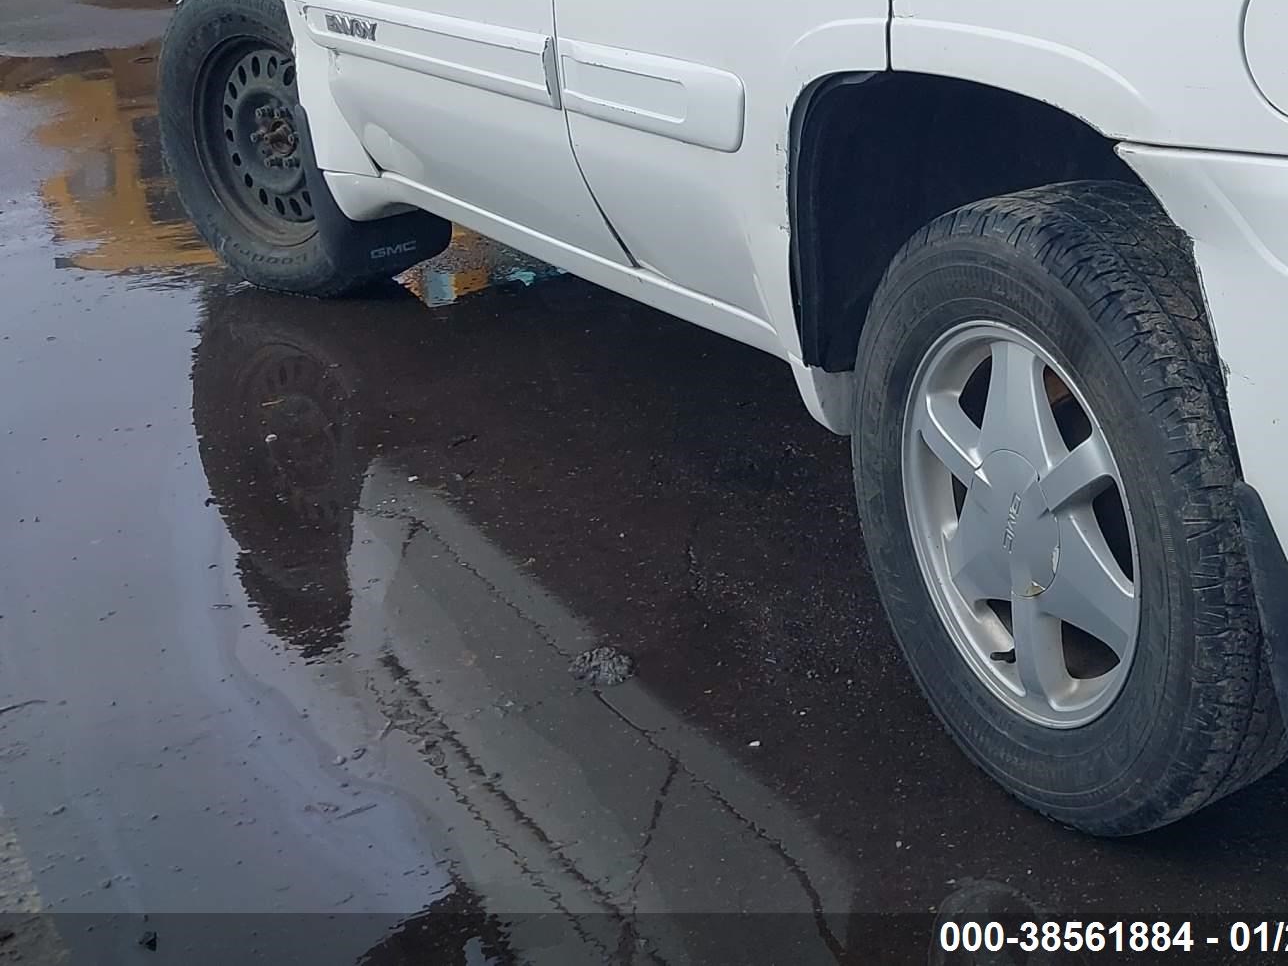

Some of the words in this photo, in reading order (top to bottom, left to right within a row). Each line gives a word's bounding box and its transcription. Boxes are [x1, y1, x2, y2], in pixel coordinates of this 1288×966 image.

[325, 14, 377, 42] ENVOY
[370, 240, 417, 259] GMC
[1003, 492, 1021, 554] GMC
